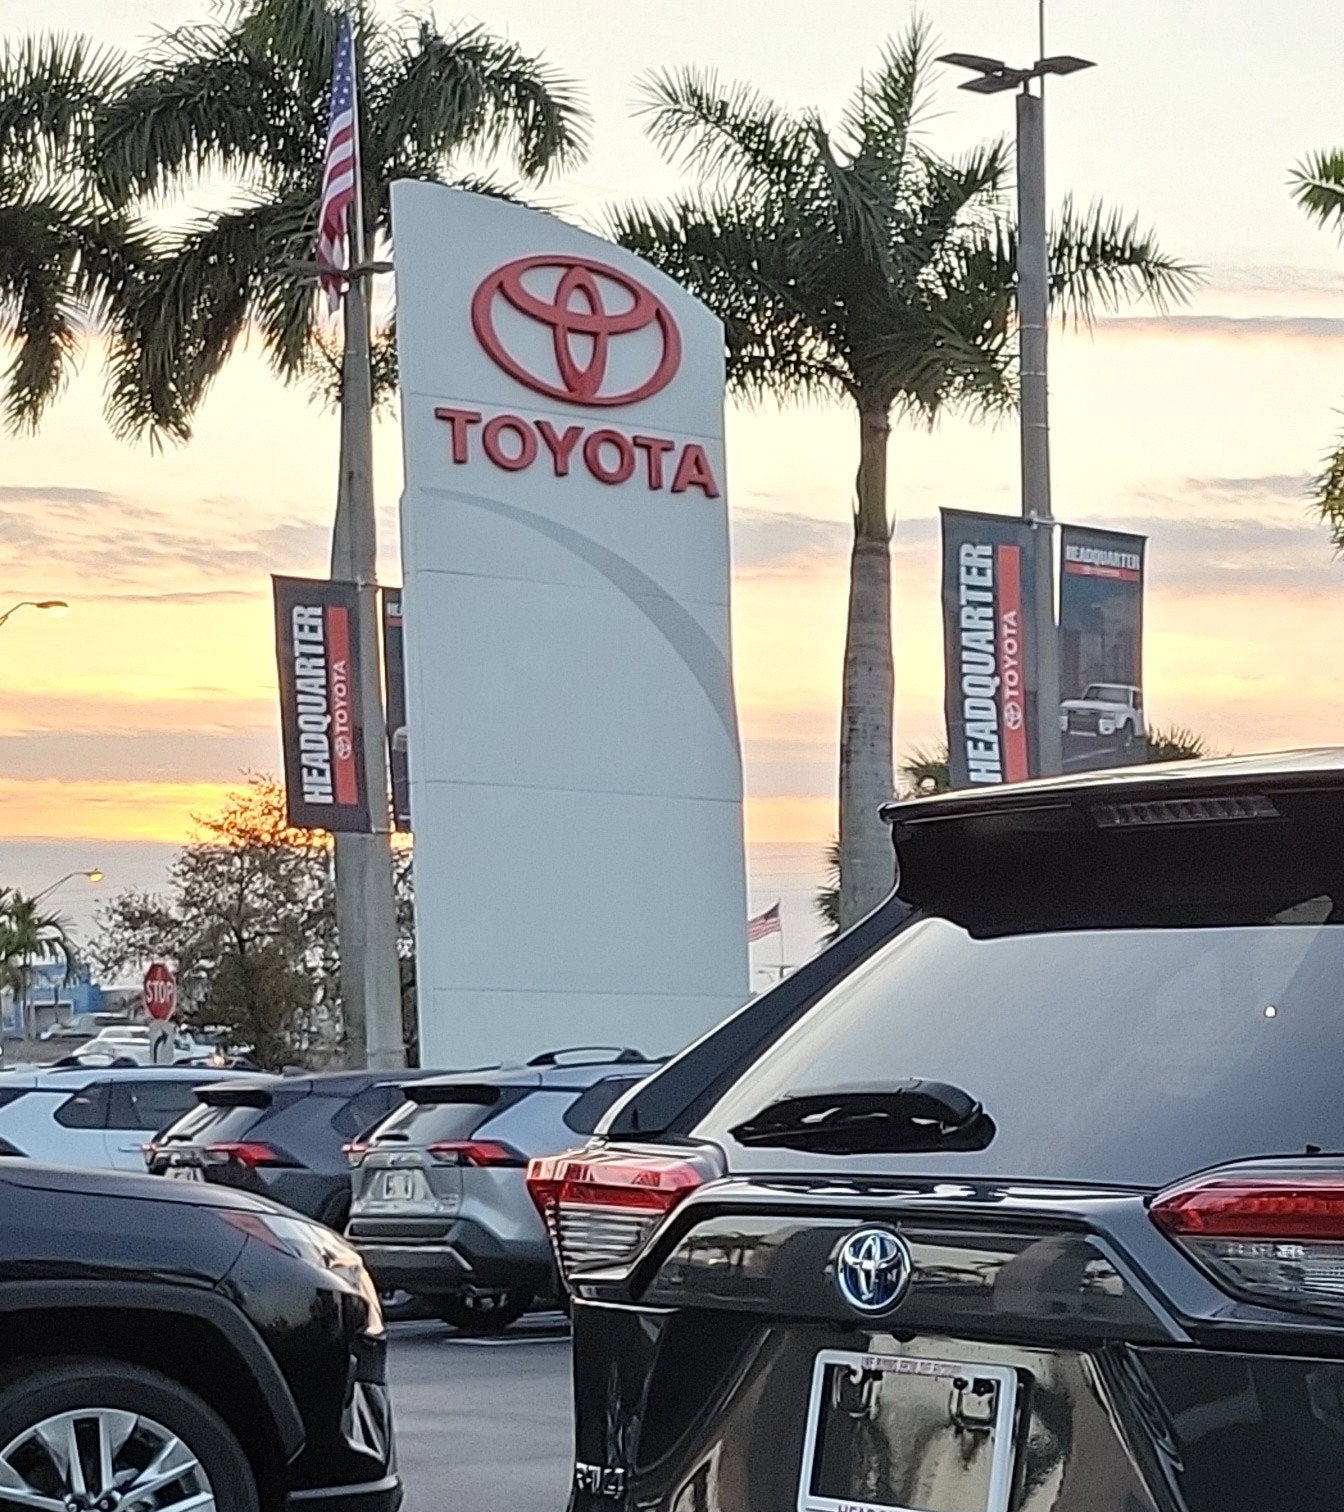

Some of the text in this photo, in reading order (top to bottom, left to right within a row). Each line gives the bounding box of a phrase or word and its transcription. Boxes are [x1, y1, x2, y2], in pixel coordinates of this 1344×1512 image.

[434, 407, 720, 498] TOYOTA
[333, 660, 351, 733] TOYOTA
[960, 543, 1003, 784] HEADQUARTER
[1002, 610, 1019, 699] TOYOTA
[292, 604, 334, 805] HEADQUARTER
[146, 980, 174, 1003] STOP
